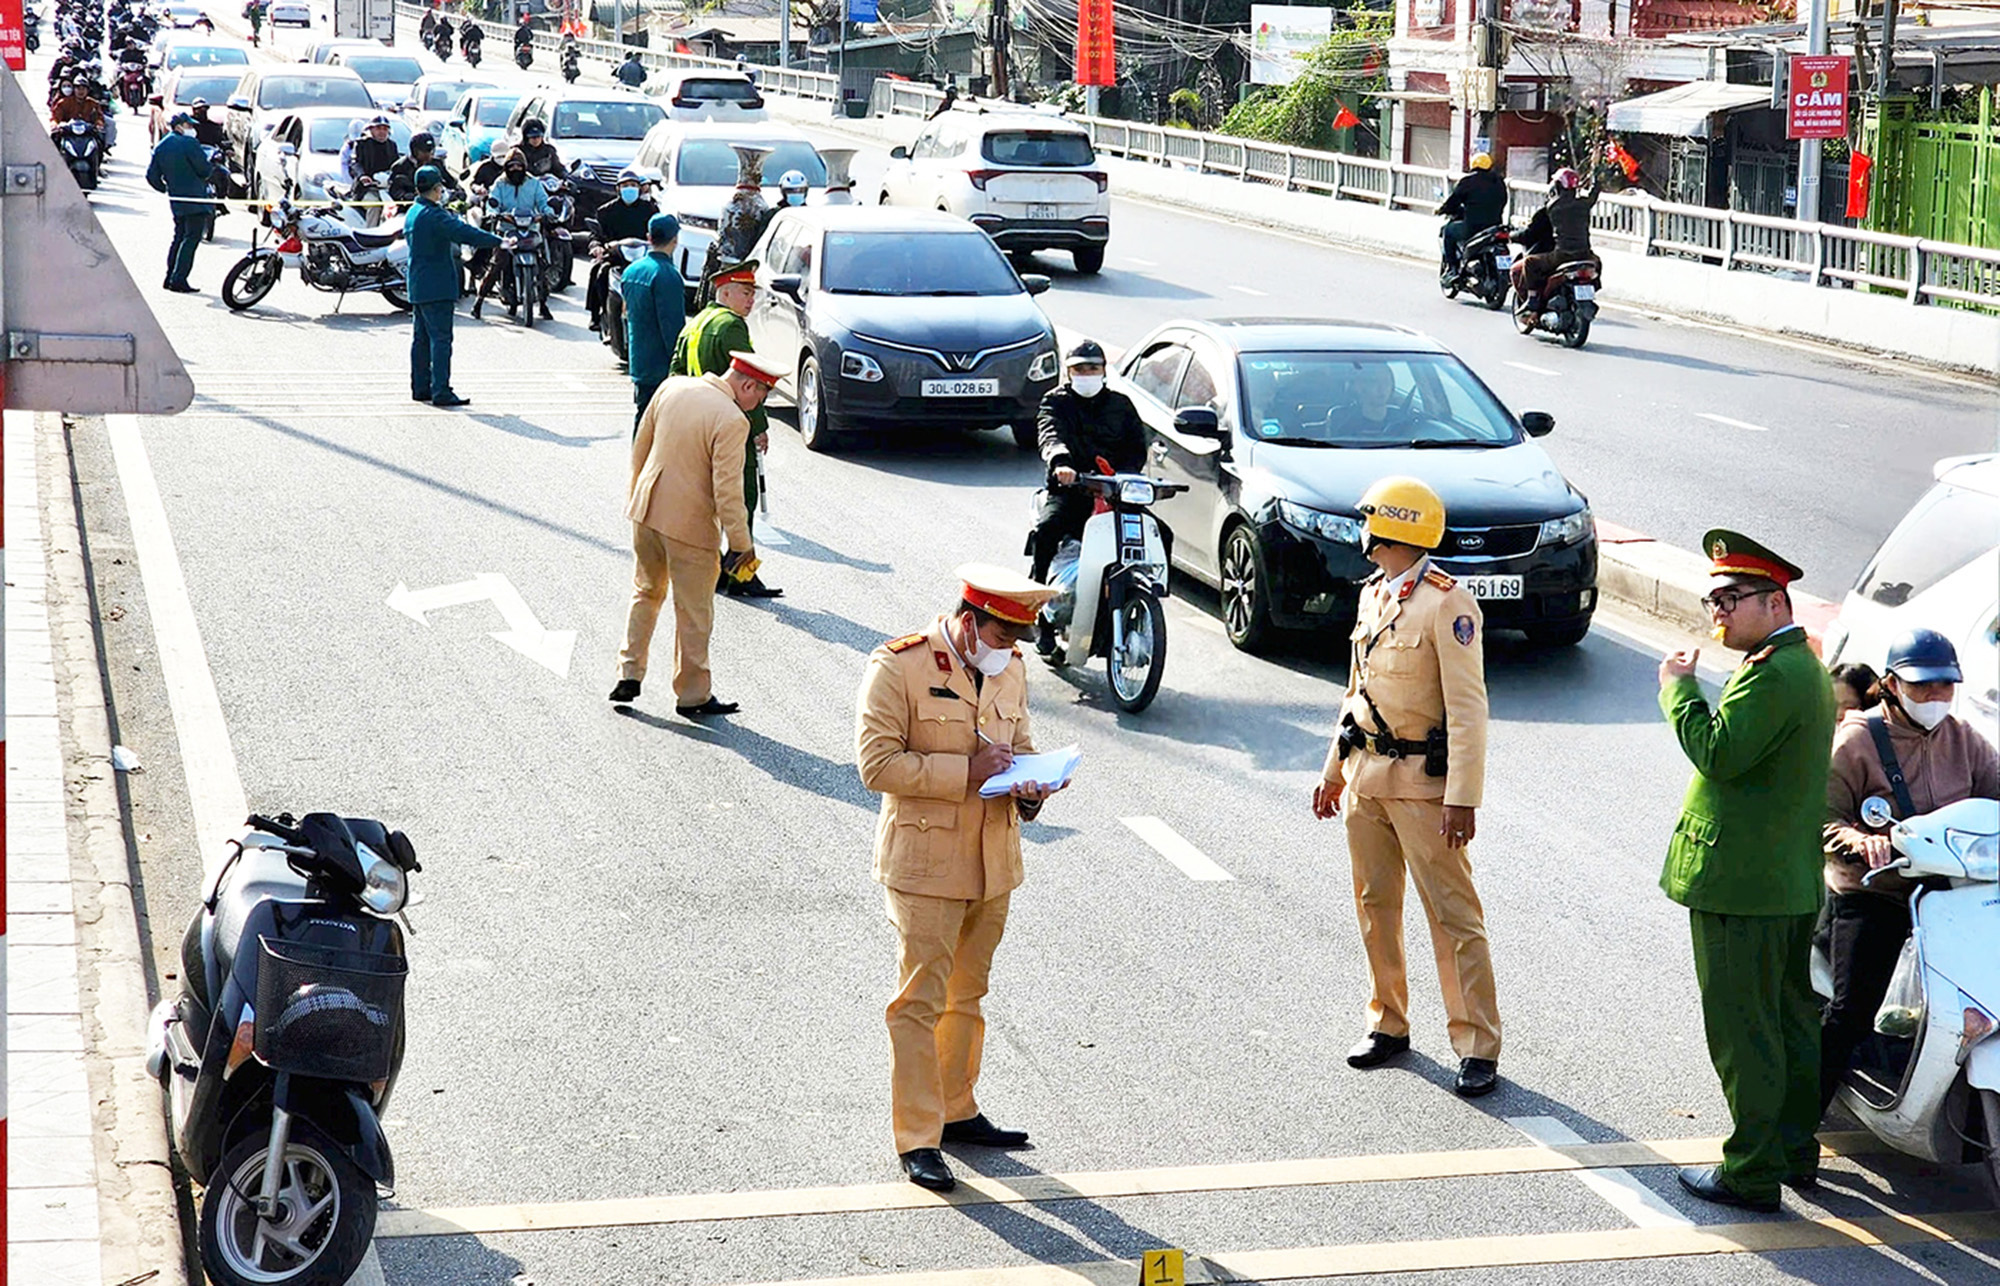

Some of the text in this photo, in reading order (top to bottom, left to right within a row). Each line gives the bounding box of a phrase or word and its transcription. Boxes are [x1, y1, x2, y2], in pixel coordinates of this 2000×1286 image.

[1795, 89, 1842, 106] CẤM
[1378, 504, 1421, 523] CSGT
[310, 919, 356, 932] HONDA
[1153, 1255, 1173, 1284] 1
